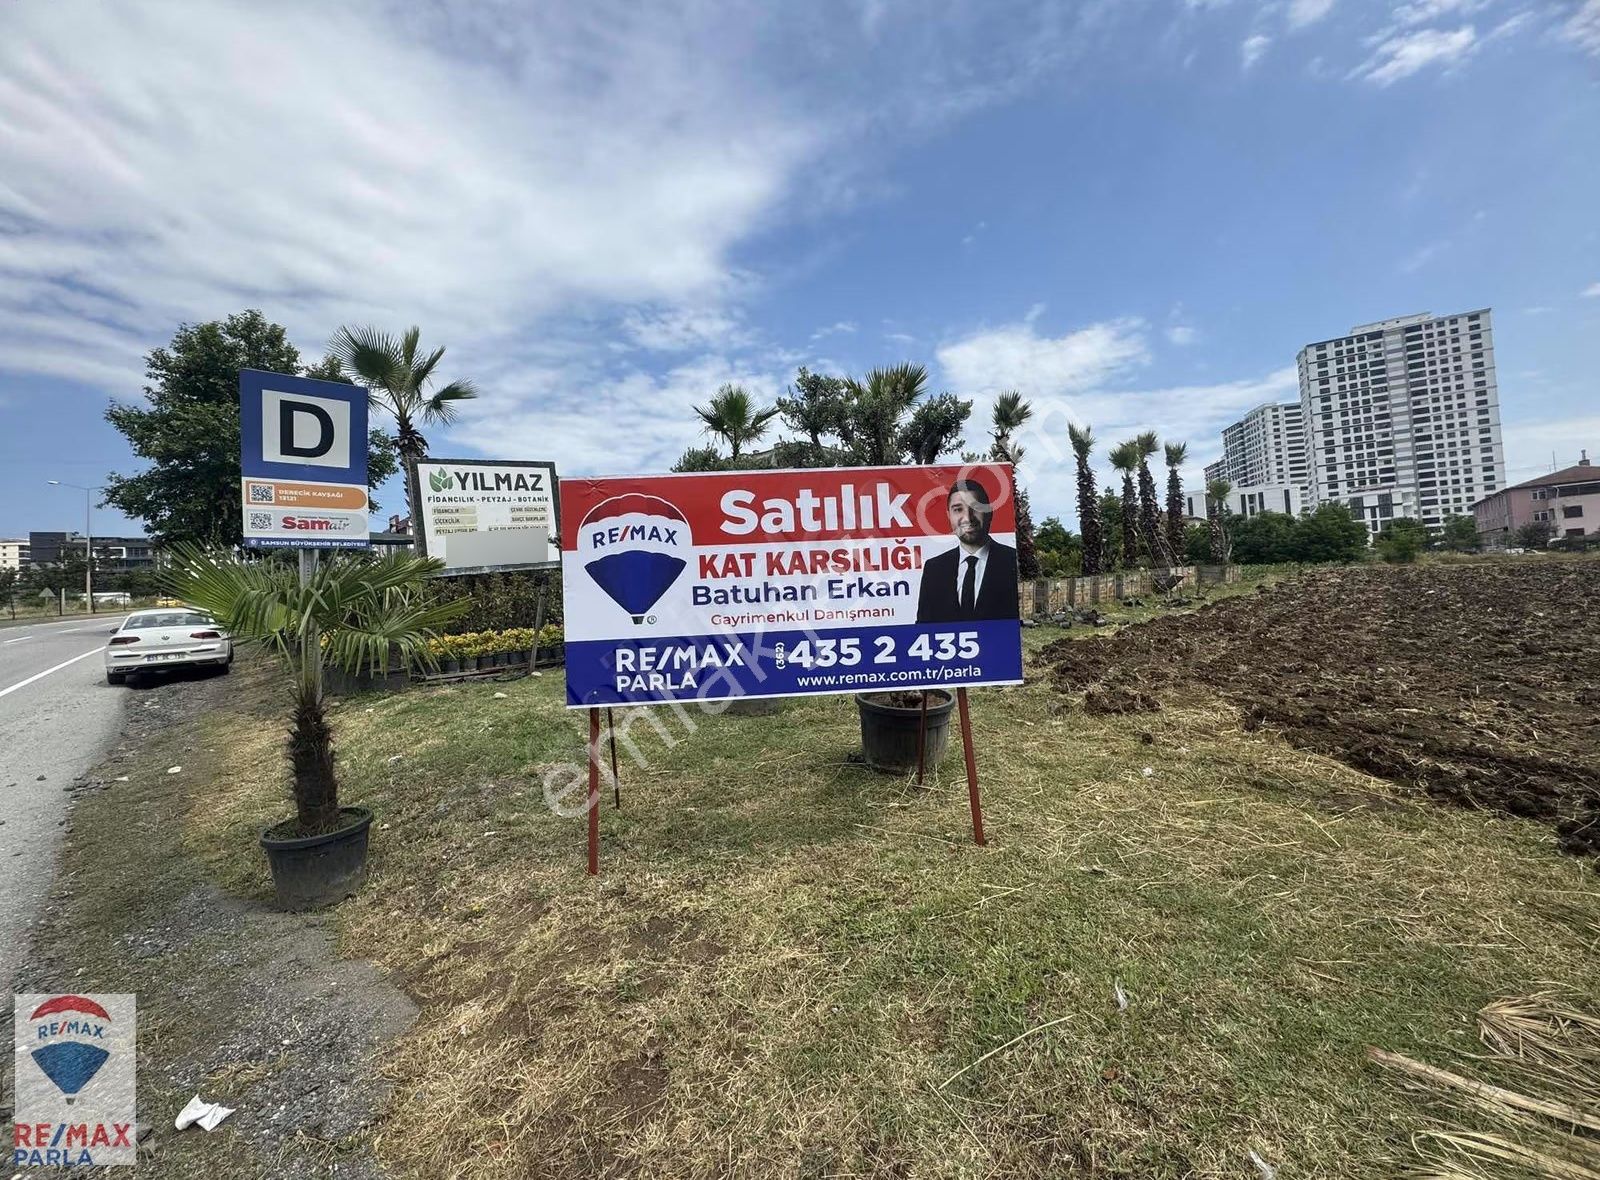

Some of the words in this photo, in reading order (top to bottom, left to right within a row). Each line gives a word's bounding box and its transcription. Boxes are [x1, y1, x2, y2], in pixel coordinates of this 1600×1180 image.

[280, 400, 334, 458] D
[454, 472, 543, 491] YILMAZ
[428, 495, 475, 503] FİDANCILIK
[517, 495, 549, 503] BOTANİK
[719, 482, 914, 535] Satılık
[281, 516, 350, 531] Samair
[592, 525, 678, 549] RE/MAX
[699, 553, 756, 579] KAT
[766, 538, 922, 577] KARŞILIĞI
[692, 581, 817, 606] Batuhan
[827, 577, 910, 600] Erkan
[711, 609, 809, 627] Gayrimenkul
[814, 607, 895, 623] Danışmanı
[615, 642, 745, 672] RE/MAX
[775, 642, 786, 670] (362)
[787, 637, 862, 668] 435
[873, 635, 897, 664] 2
[907, 631, 980, 662] 435
[616, 672, 698, 693] PARLA
[797, 665, 982, 687] www.remax.com.tr/parla
